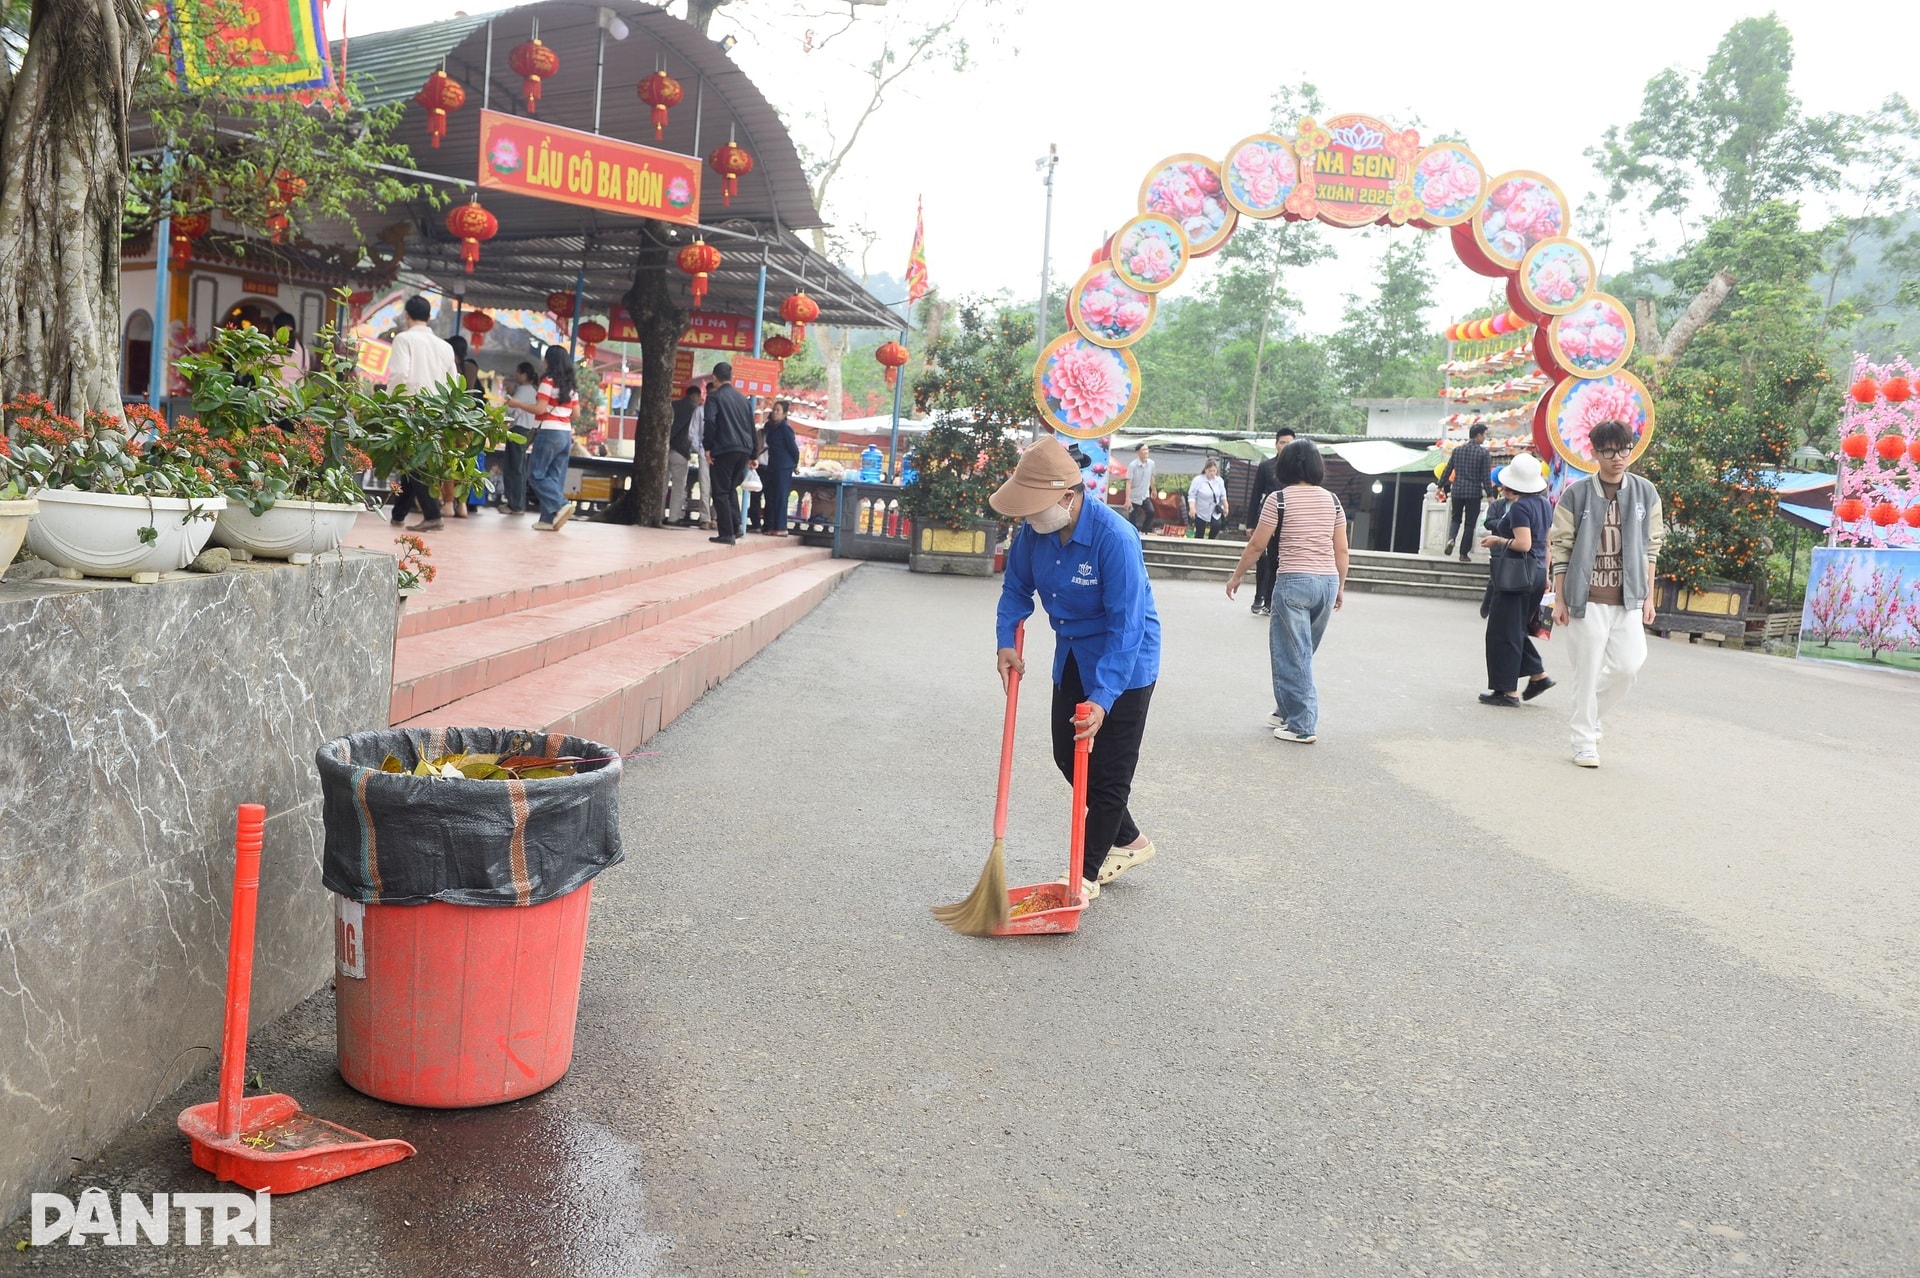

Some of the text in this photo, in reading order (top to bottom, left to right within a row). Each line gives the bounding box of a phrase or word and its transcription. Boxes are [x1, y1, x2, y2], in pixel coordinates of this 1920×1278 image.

[526, 135, 664, 209] LẦU CÔ BA ĐÓN
[1315, 151, 1396, 179] NA SƠN
[1317, 183, 1393, 206] XUÂN 2026
[708, 319, 727, 328] NA
